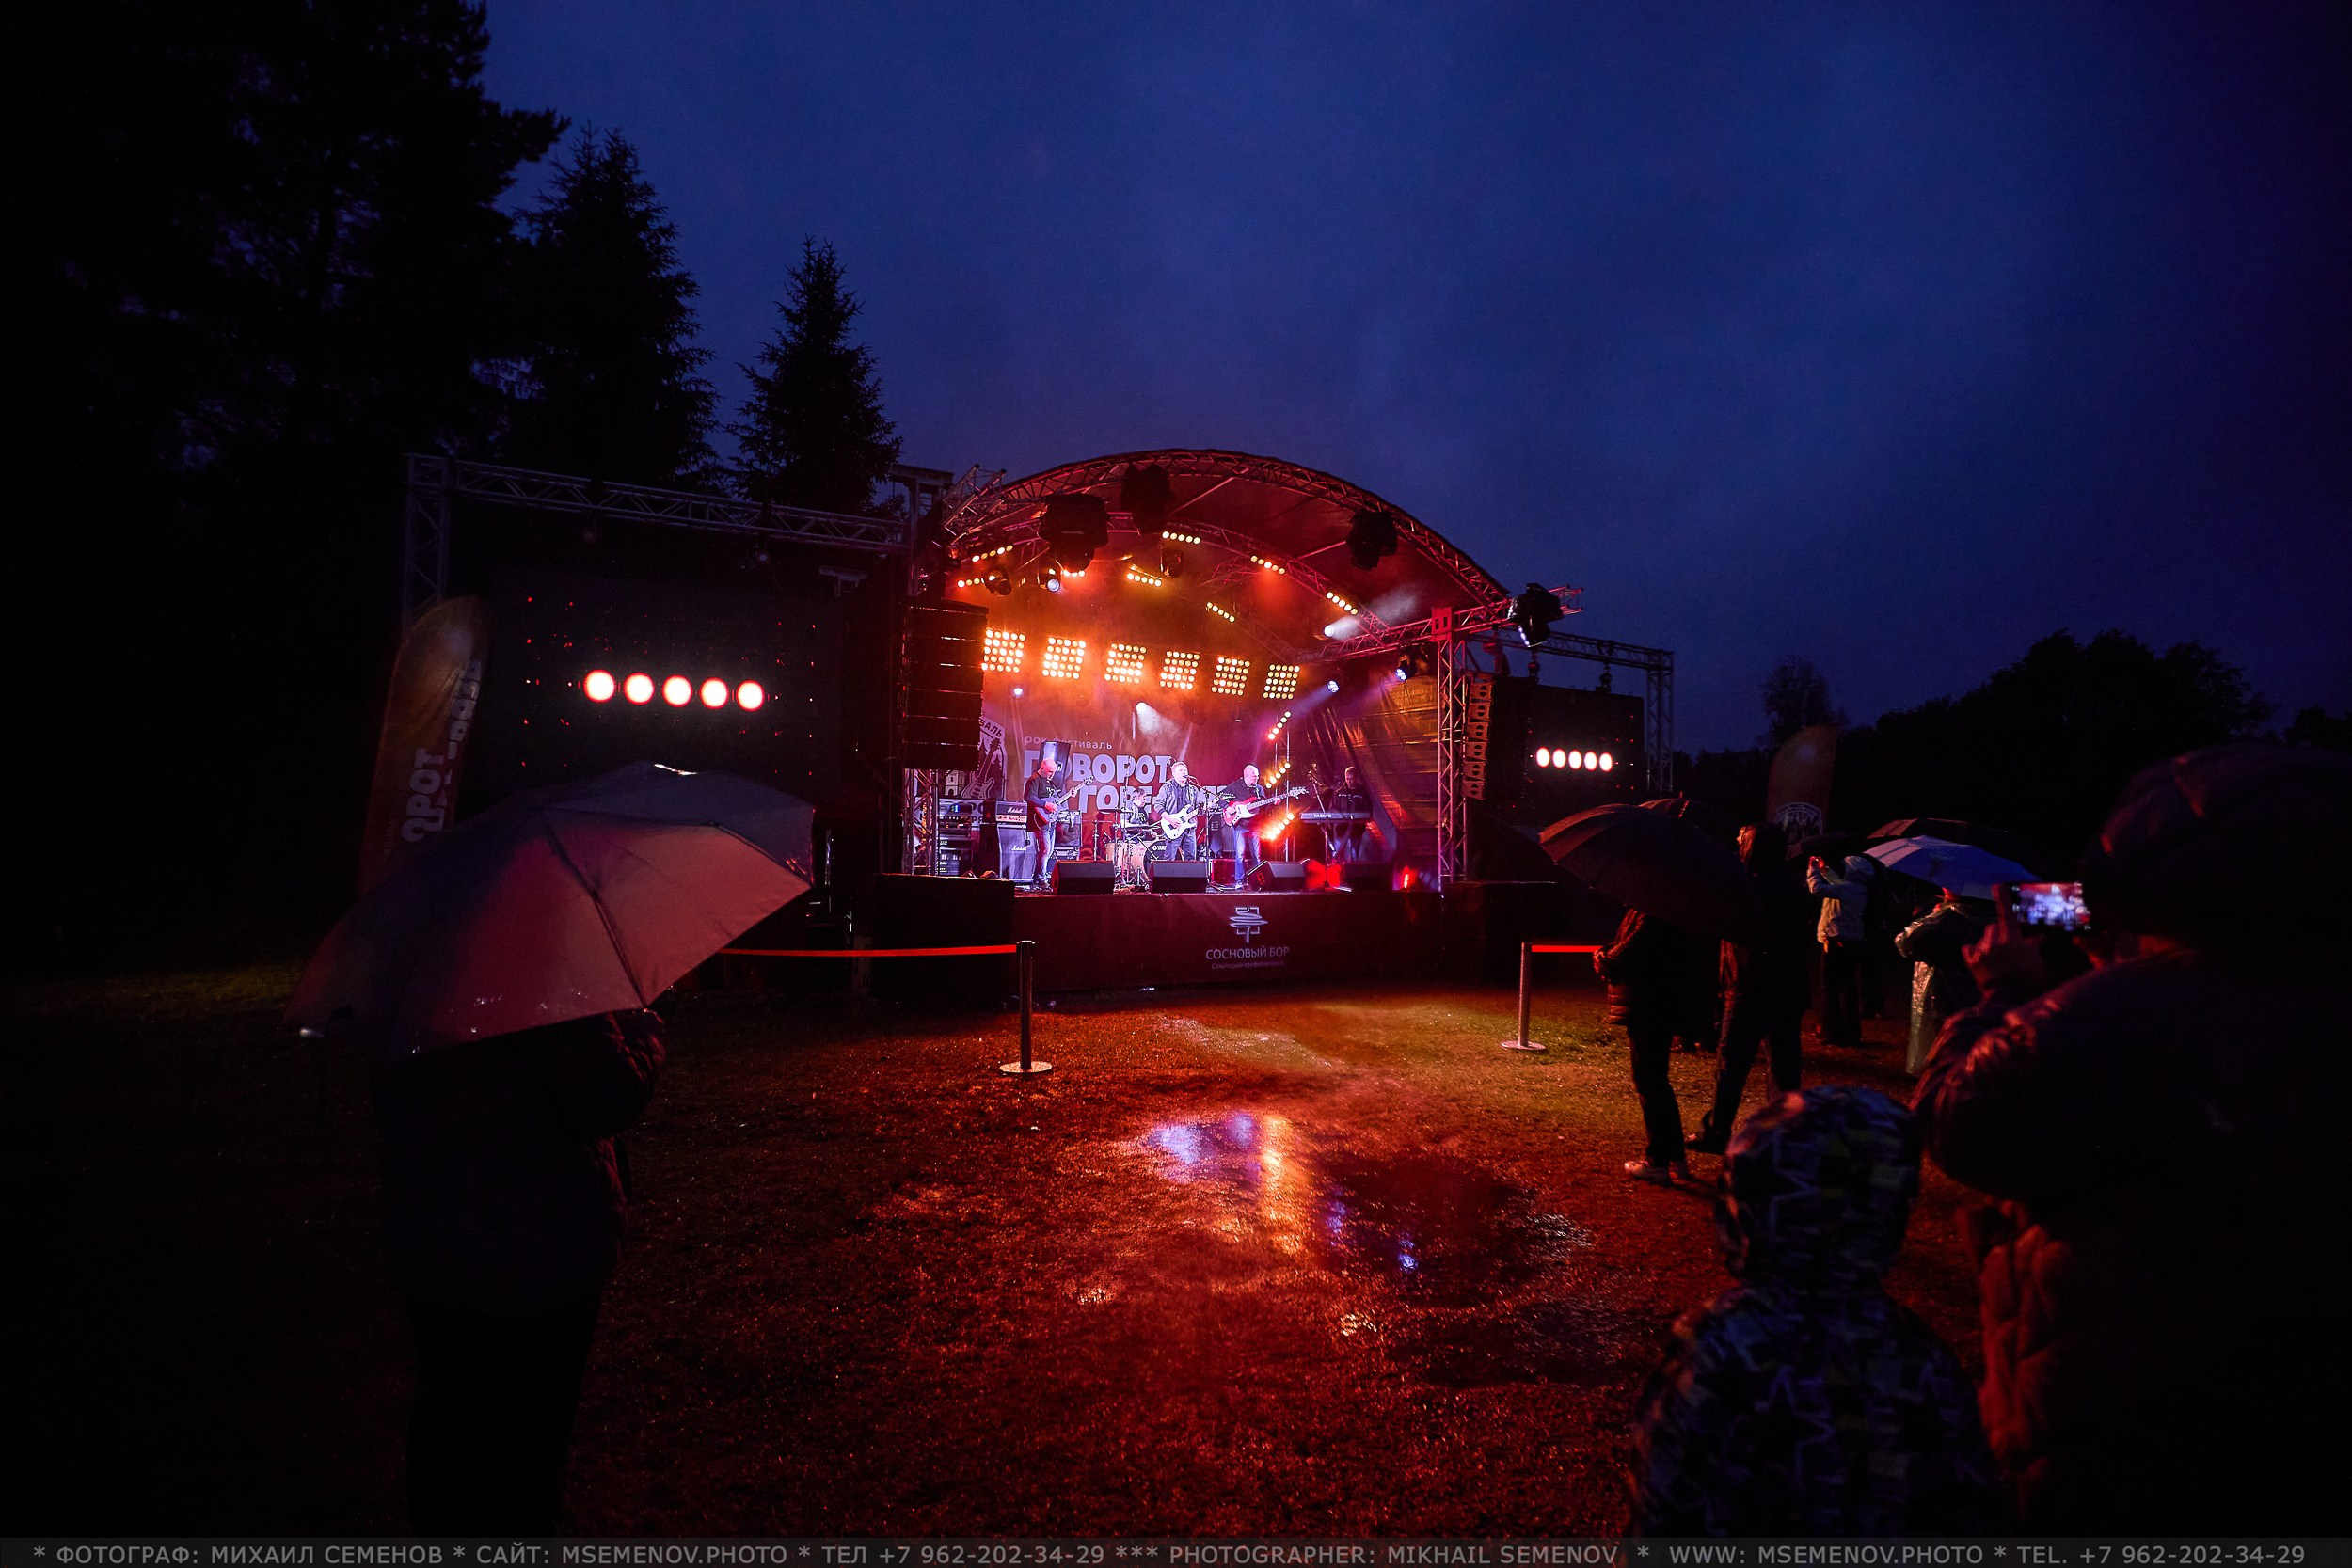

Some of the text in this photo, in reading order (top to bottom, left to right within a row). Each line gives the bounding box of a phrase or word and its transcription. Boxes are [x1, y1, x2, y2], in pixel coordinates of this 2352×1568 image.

[1024, 749, 1174, 784] ПВОРОТ
[1205, 945, 1291, 960] СОСНОВЫЙ БОР
